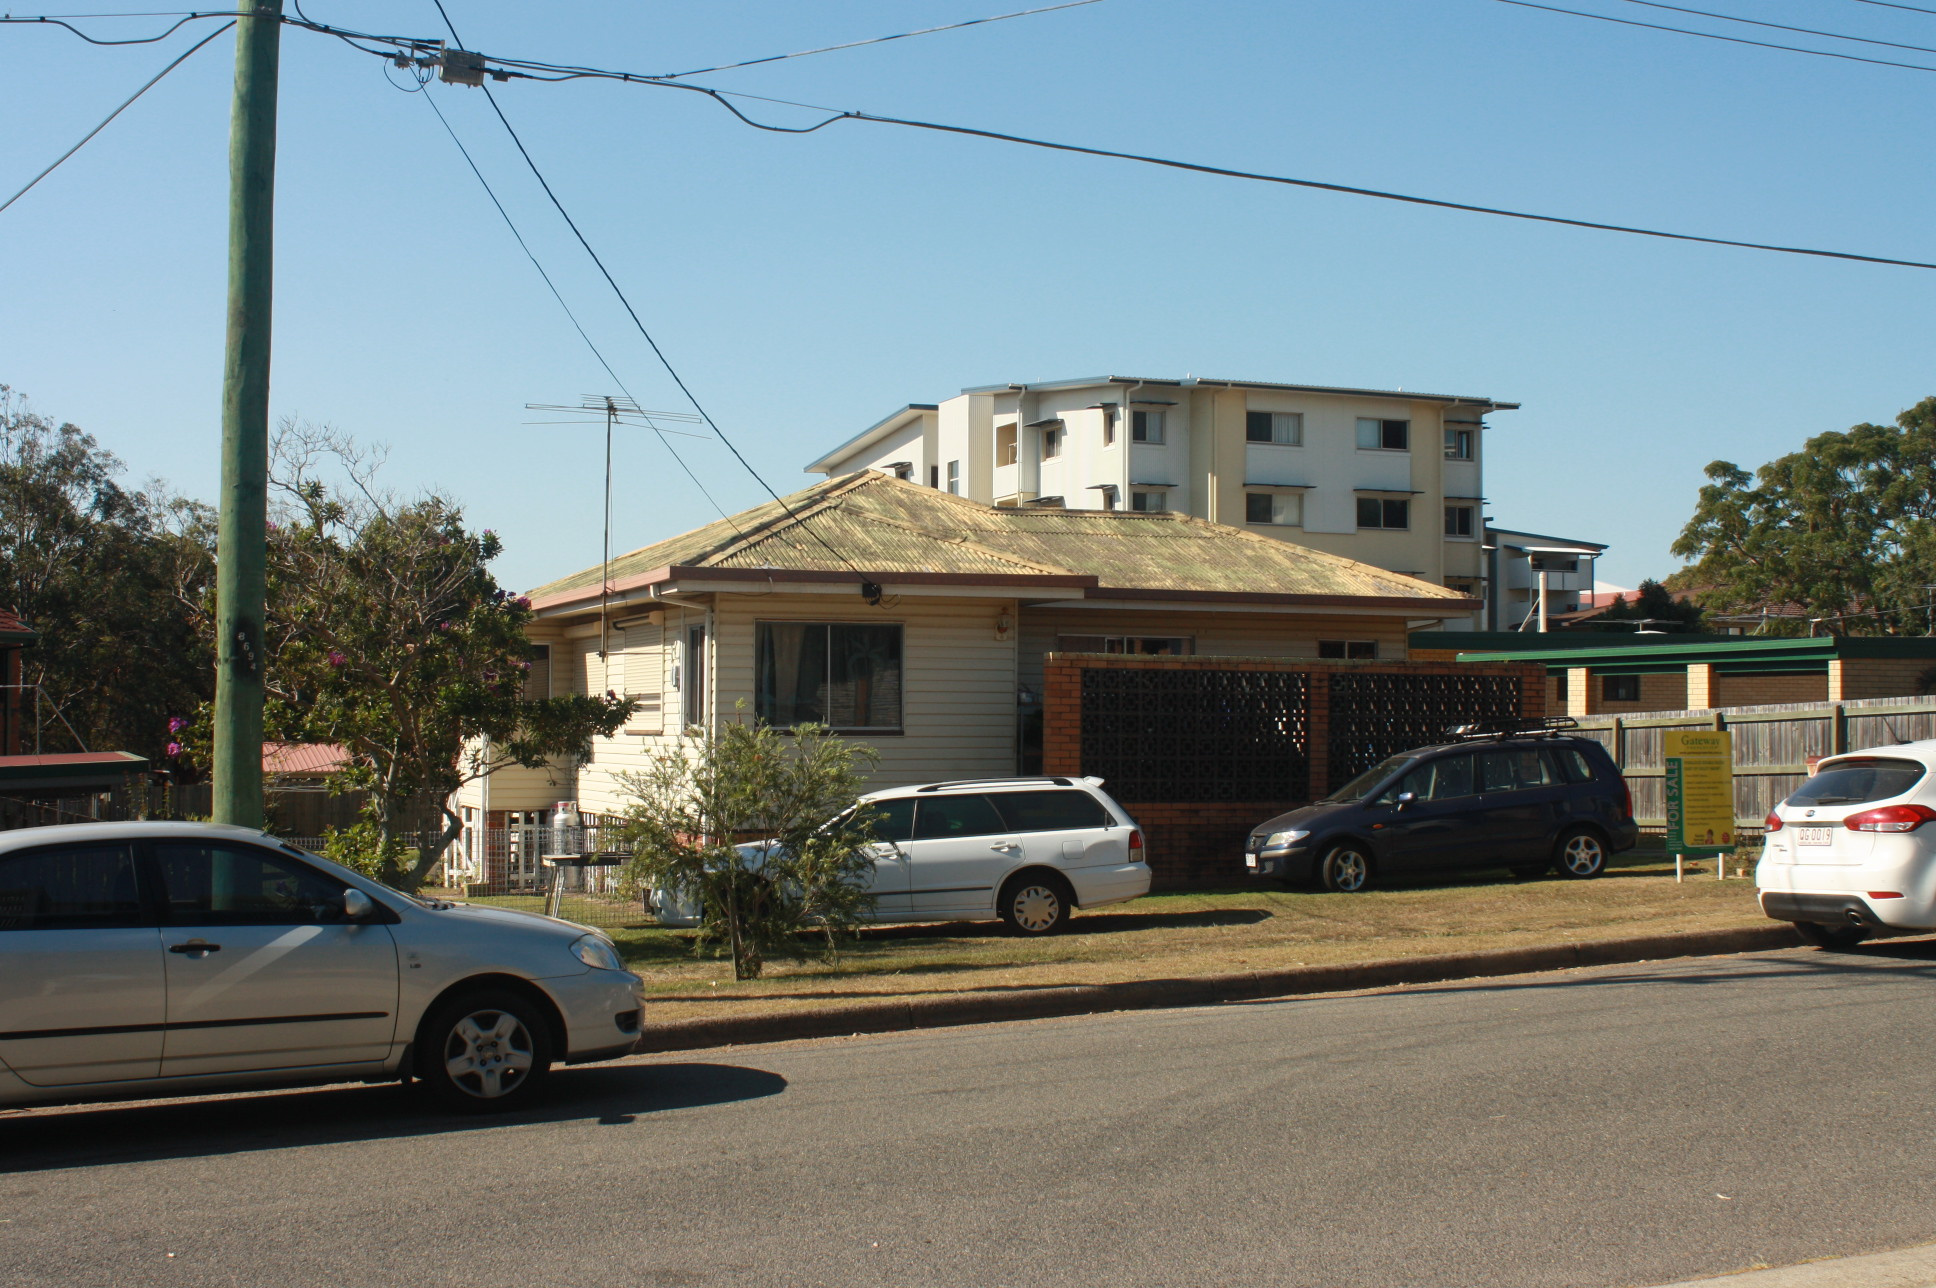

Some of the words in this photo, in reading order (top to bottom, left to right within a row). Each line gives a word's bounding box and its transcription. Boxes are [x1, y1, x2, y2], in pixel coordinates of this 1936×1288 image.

[1680, 734, 1720, 746] Gateway
[1666, 761, 1679, 797] SALE
[1667, 801, 1680, 830] FOR
